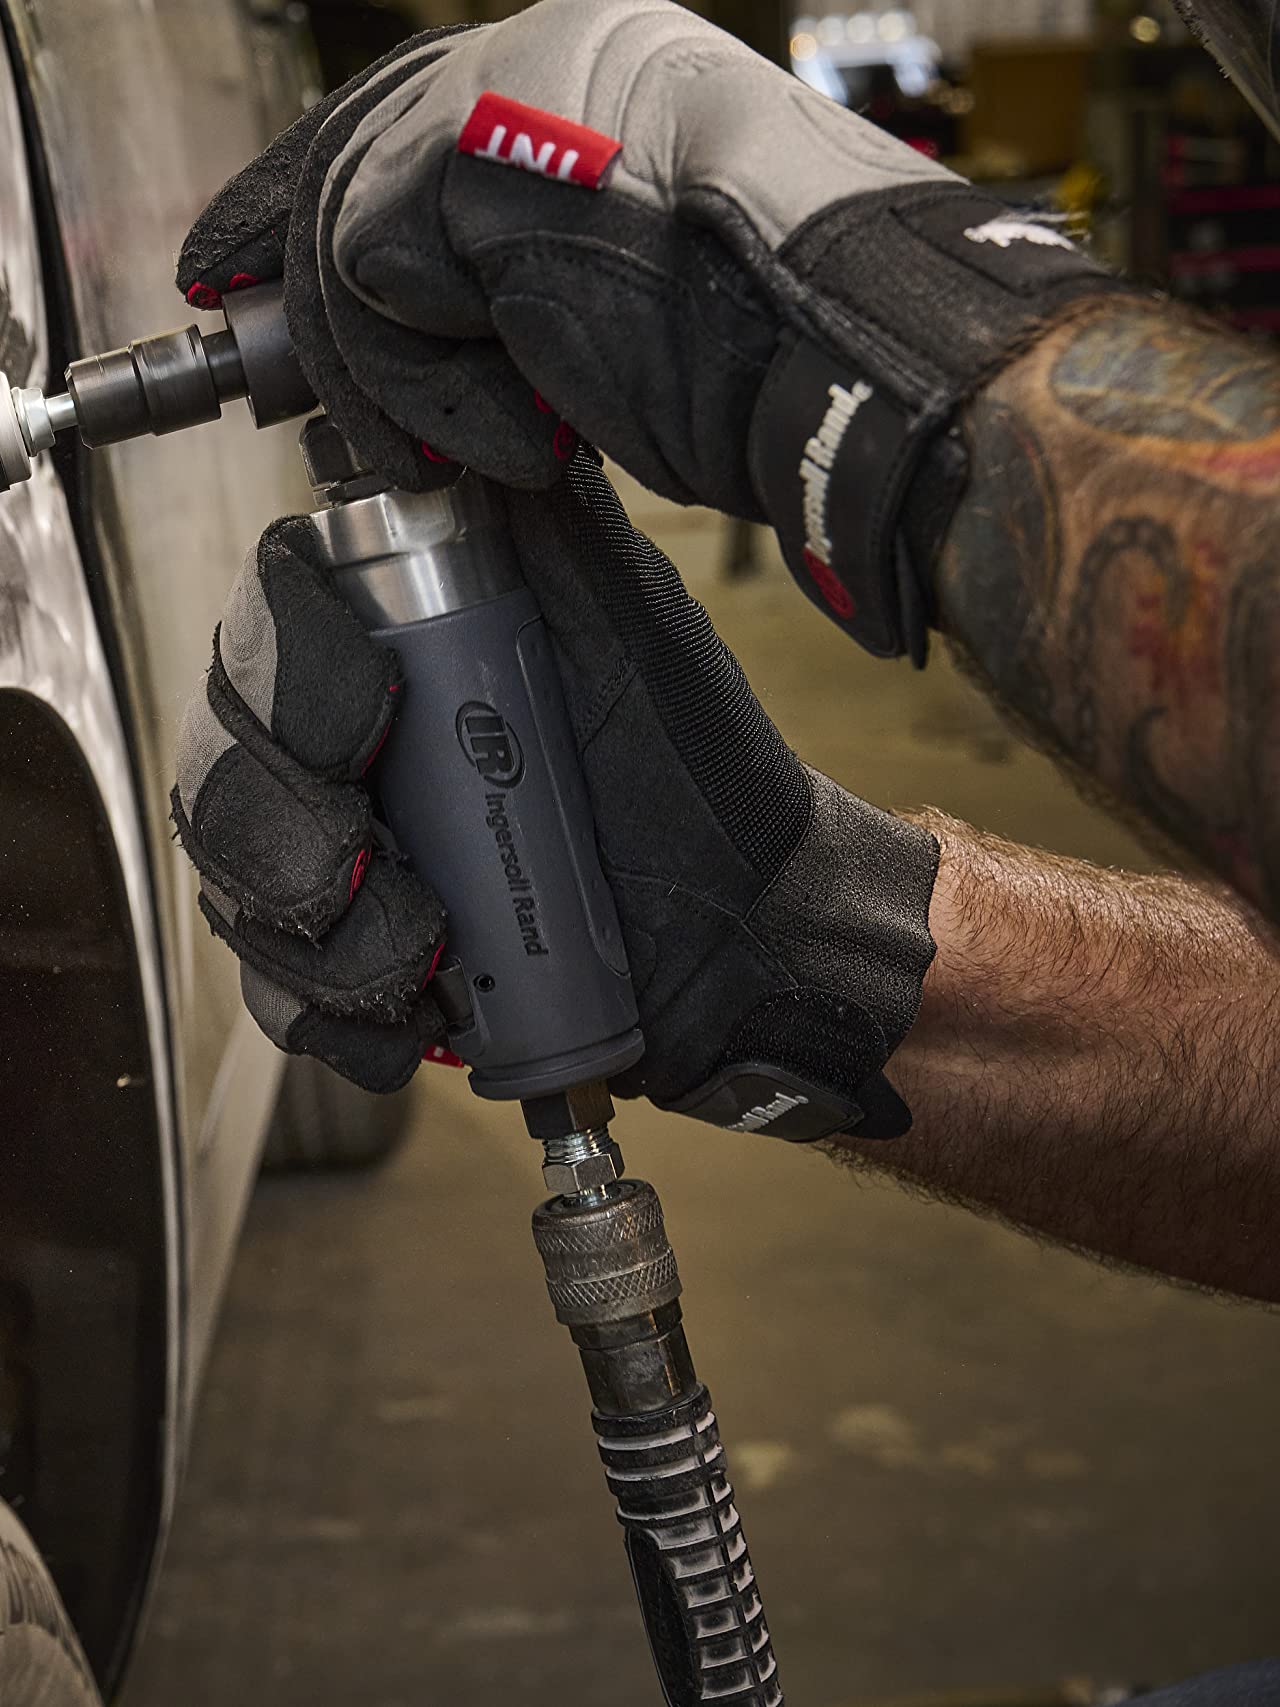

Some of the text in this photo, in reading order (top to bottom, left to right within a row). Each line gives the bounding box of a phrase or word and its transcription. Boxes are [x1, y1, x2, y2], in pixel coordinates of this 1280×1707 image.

[474, 124, 582, 184] TNT
[464, 714, 516, 777] IR
[485, 793, 550, 957] Ingersoll Rand
